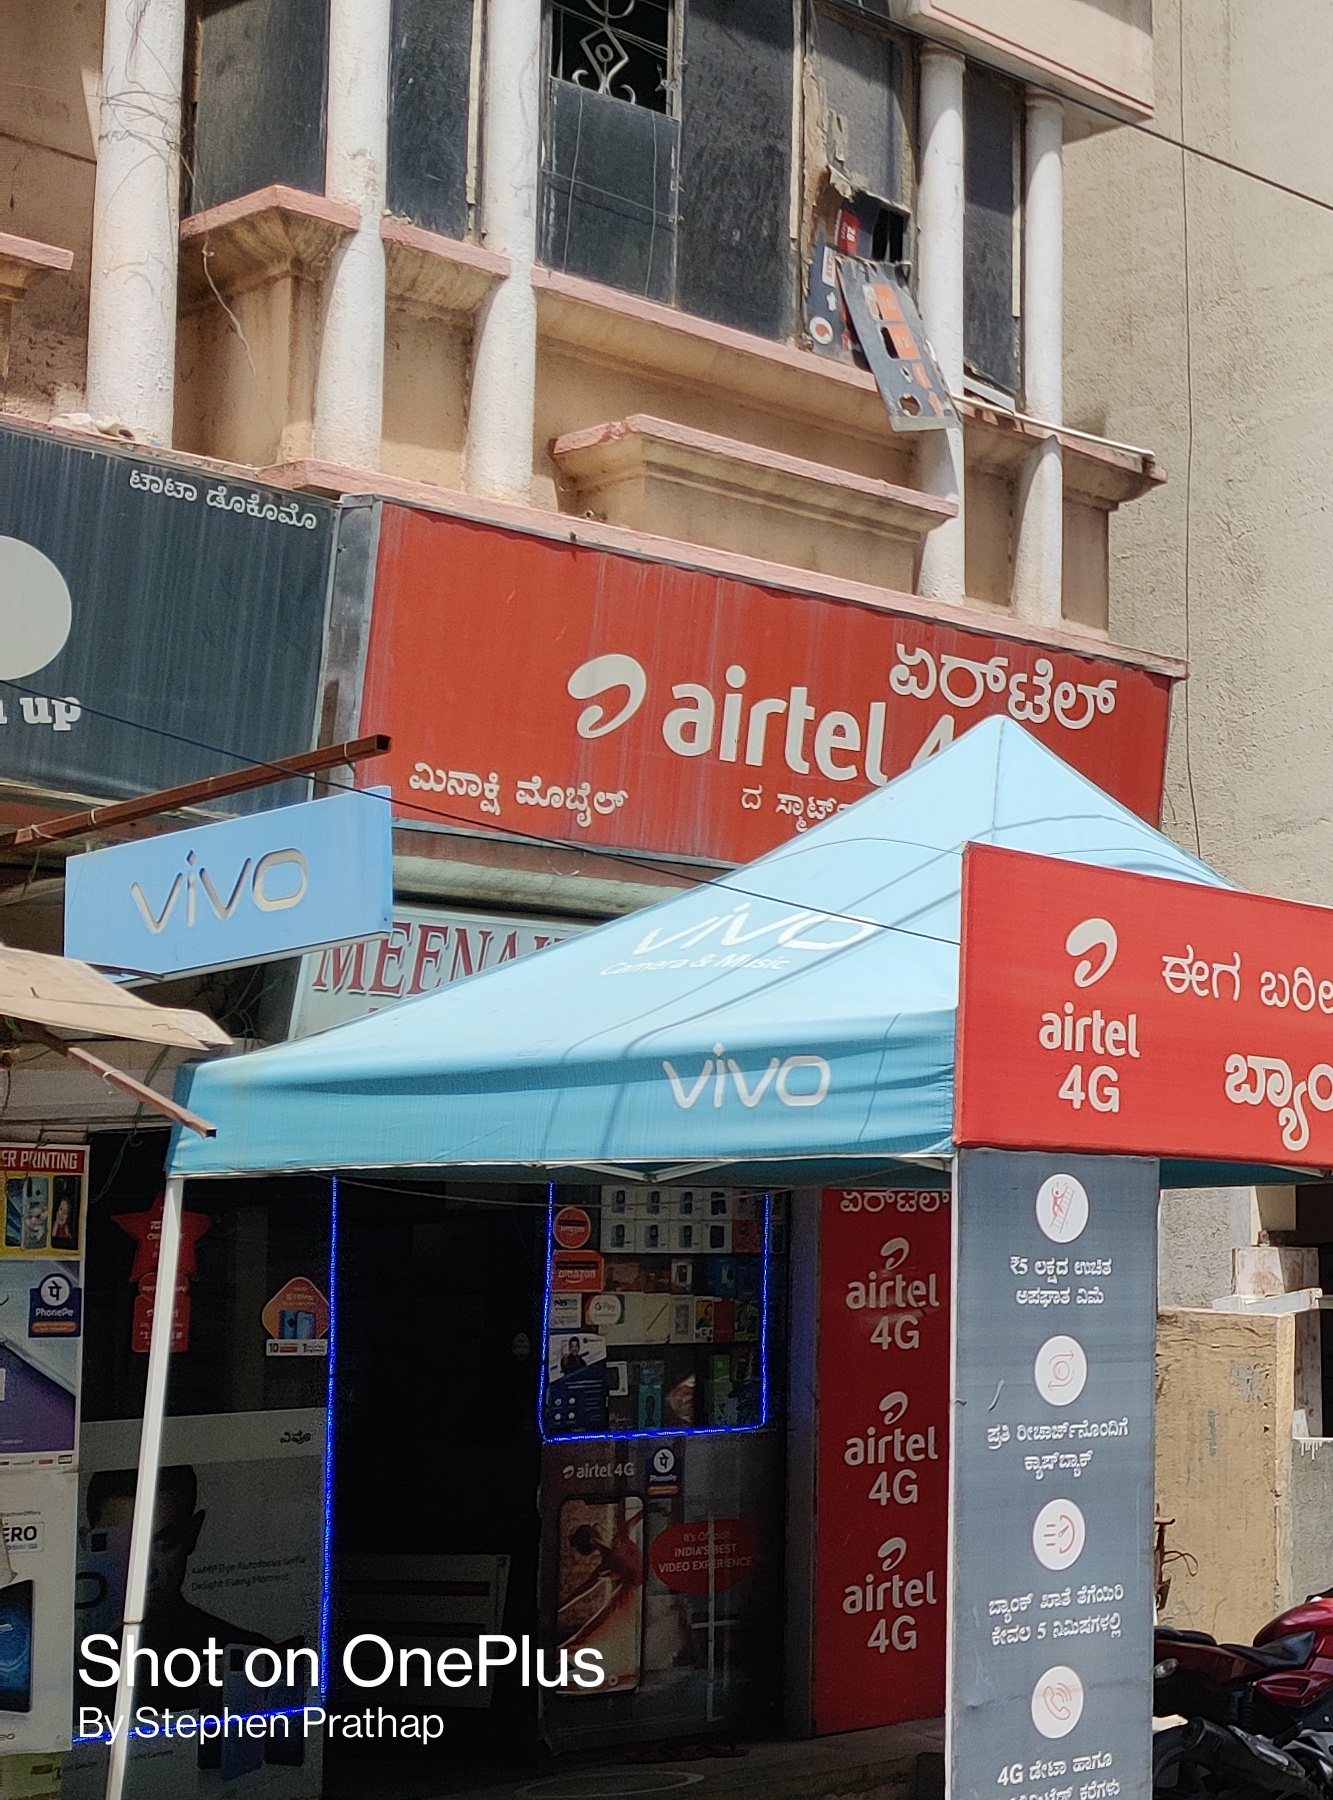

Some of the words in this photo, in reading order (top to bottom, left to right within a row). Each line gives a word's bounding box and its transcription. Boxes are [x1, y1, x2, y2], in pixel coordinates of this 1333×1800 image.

[129, 468, 198, 501] ಟಾಟಾ
[662, 665, 888, 787] airtel
[515, 775, 628, 826] ಮೊಬೈಲ್
[131, 847, 308, 935] vivo
[718, 951, 792, 972] Music
[1160, 944, 1242, 1002] ಈಗ
[1038, 1001, 1141, 1060] airtel
[661, 1041, 832, 1110] vivo
[1057, 1065, 1122, 1114] 4G
[20, 1152, 79, 1171] PRINTING
[845, 1270, 940, 1309] airtel
[35, 1307, 74, 1318] PhonePe
[870, 1315, 920, 1351] 4G
[843, 1424, 939, 1467] airtel
[576, 1461, 612, 1479] airtel
[613, 1461, 636, 1478] 4G
[868, 1469, 919, 1506] 4G
[658, 1560, 691, 1574] VIDEO
[842, 1570, 938, 1615] airtel
[867, 1615, 917, 1654] 4G
[1037, 1622, 1047, 1640] 5
[996, 1763, 1025, 1787] 4G
